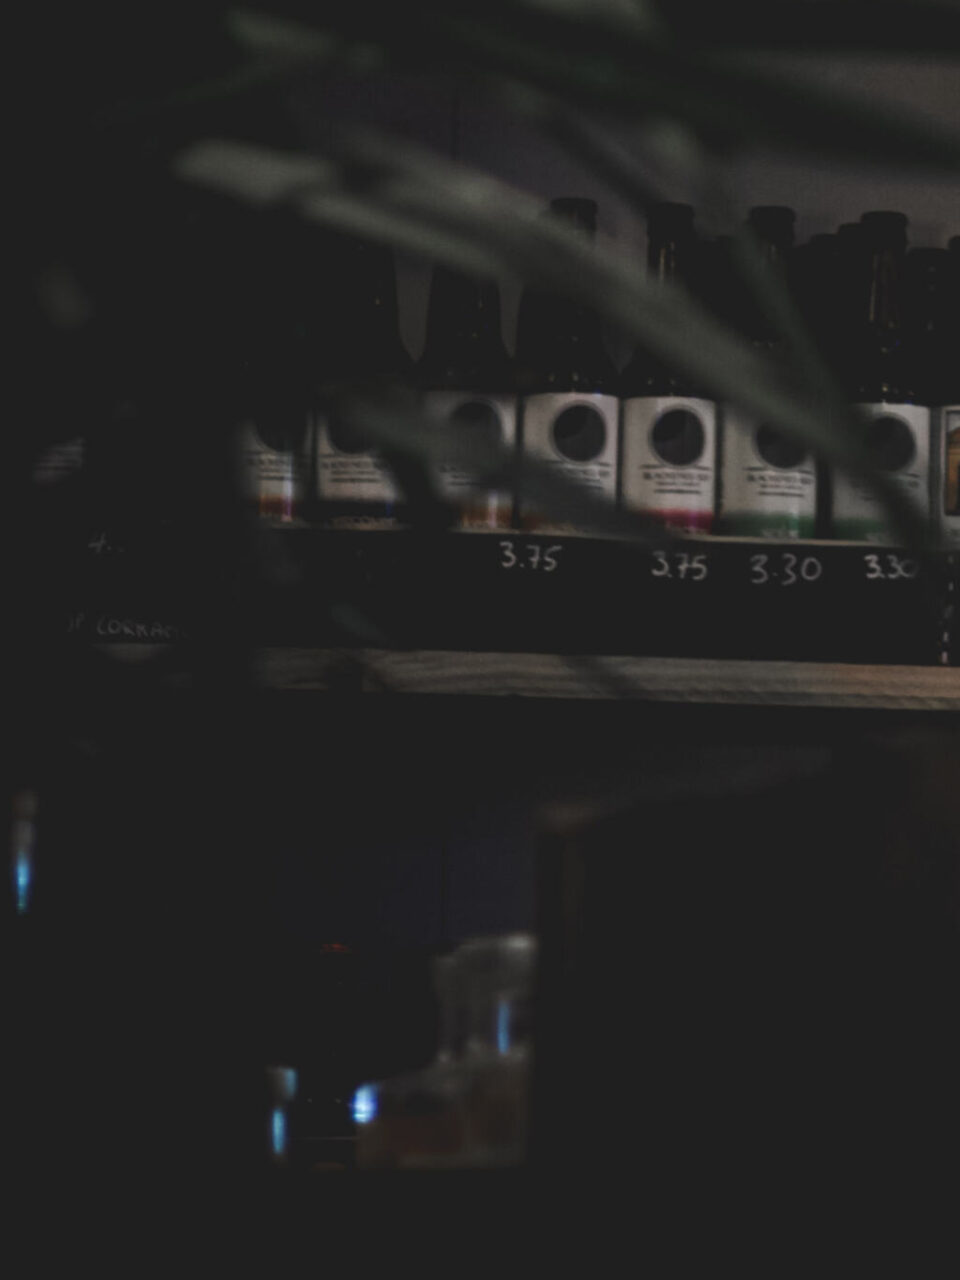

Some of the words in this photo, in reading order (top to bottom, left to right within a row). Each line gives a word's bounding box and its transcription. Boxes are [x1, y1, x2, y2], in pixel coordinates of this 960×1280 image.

[499, 540, 563, 572] 3.75
[650, 551, 709, 581] 3.75
[750, 552, 823, 587] 3.30
